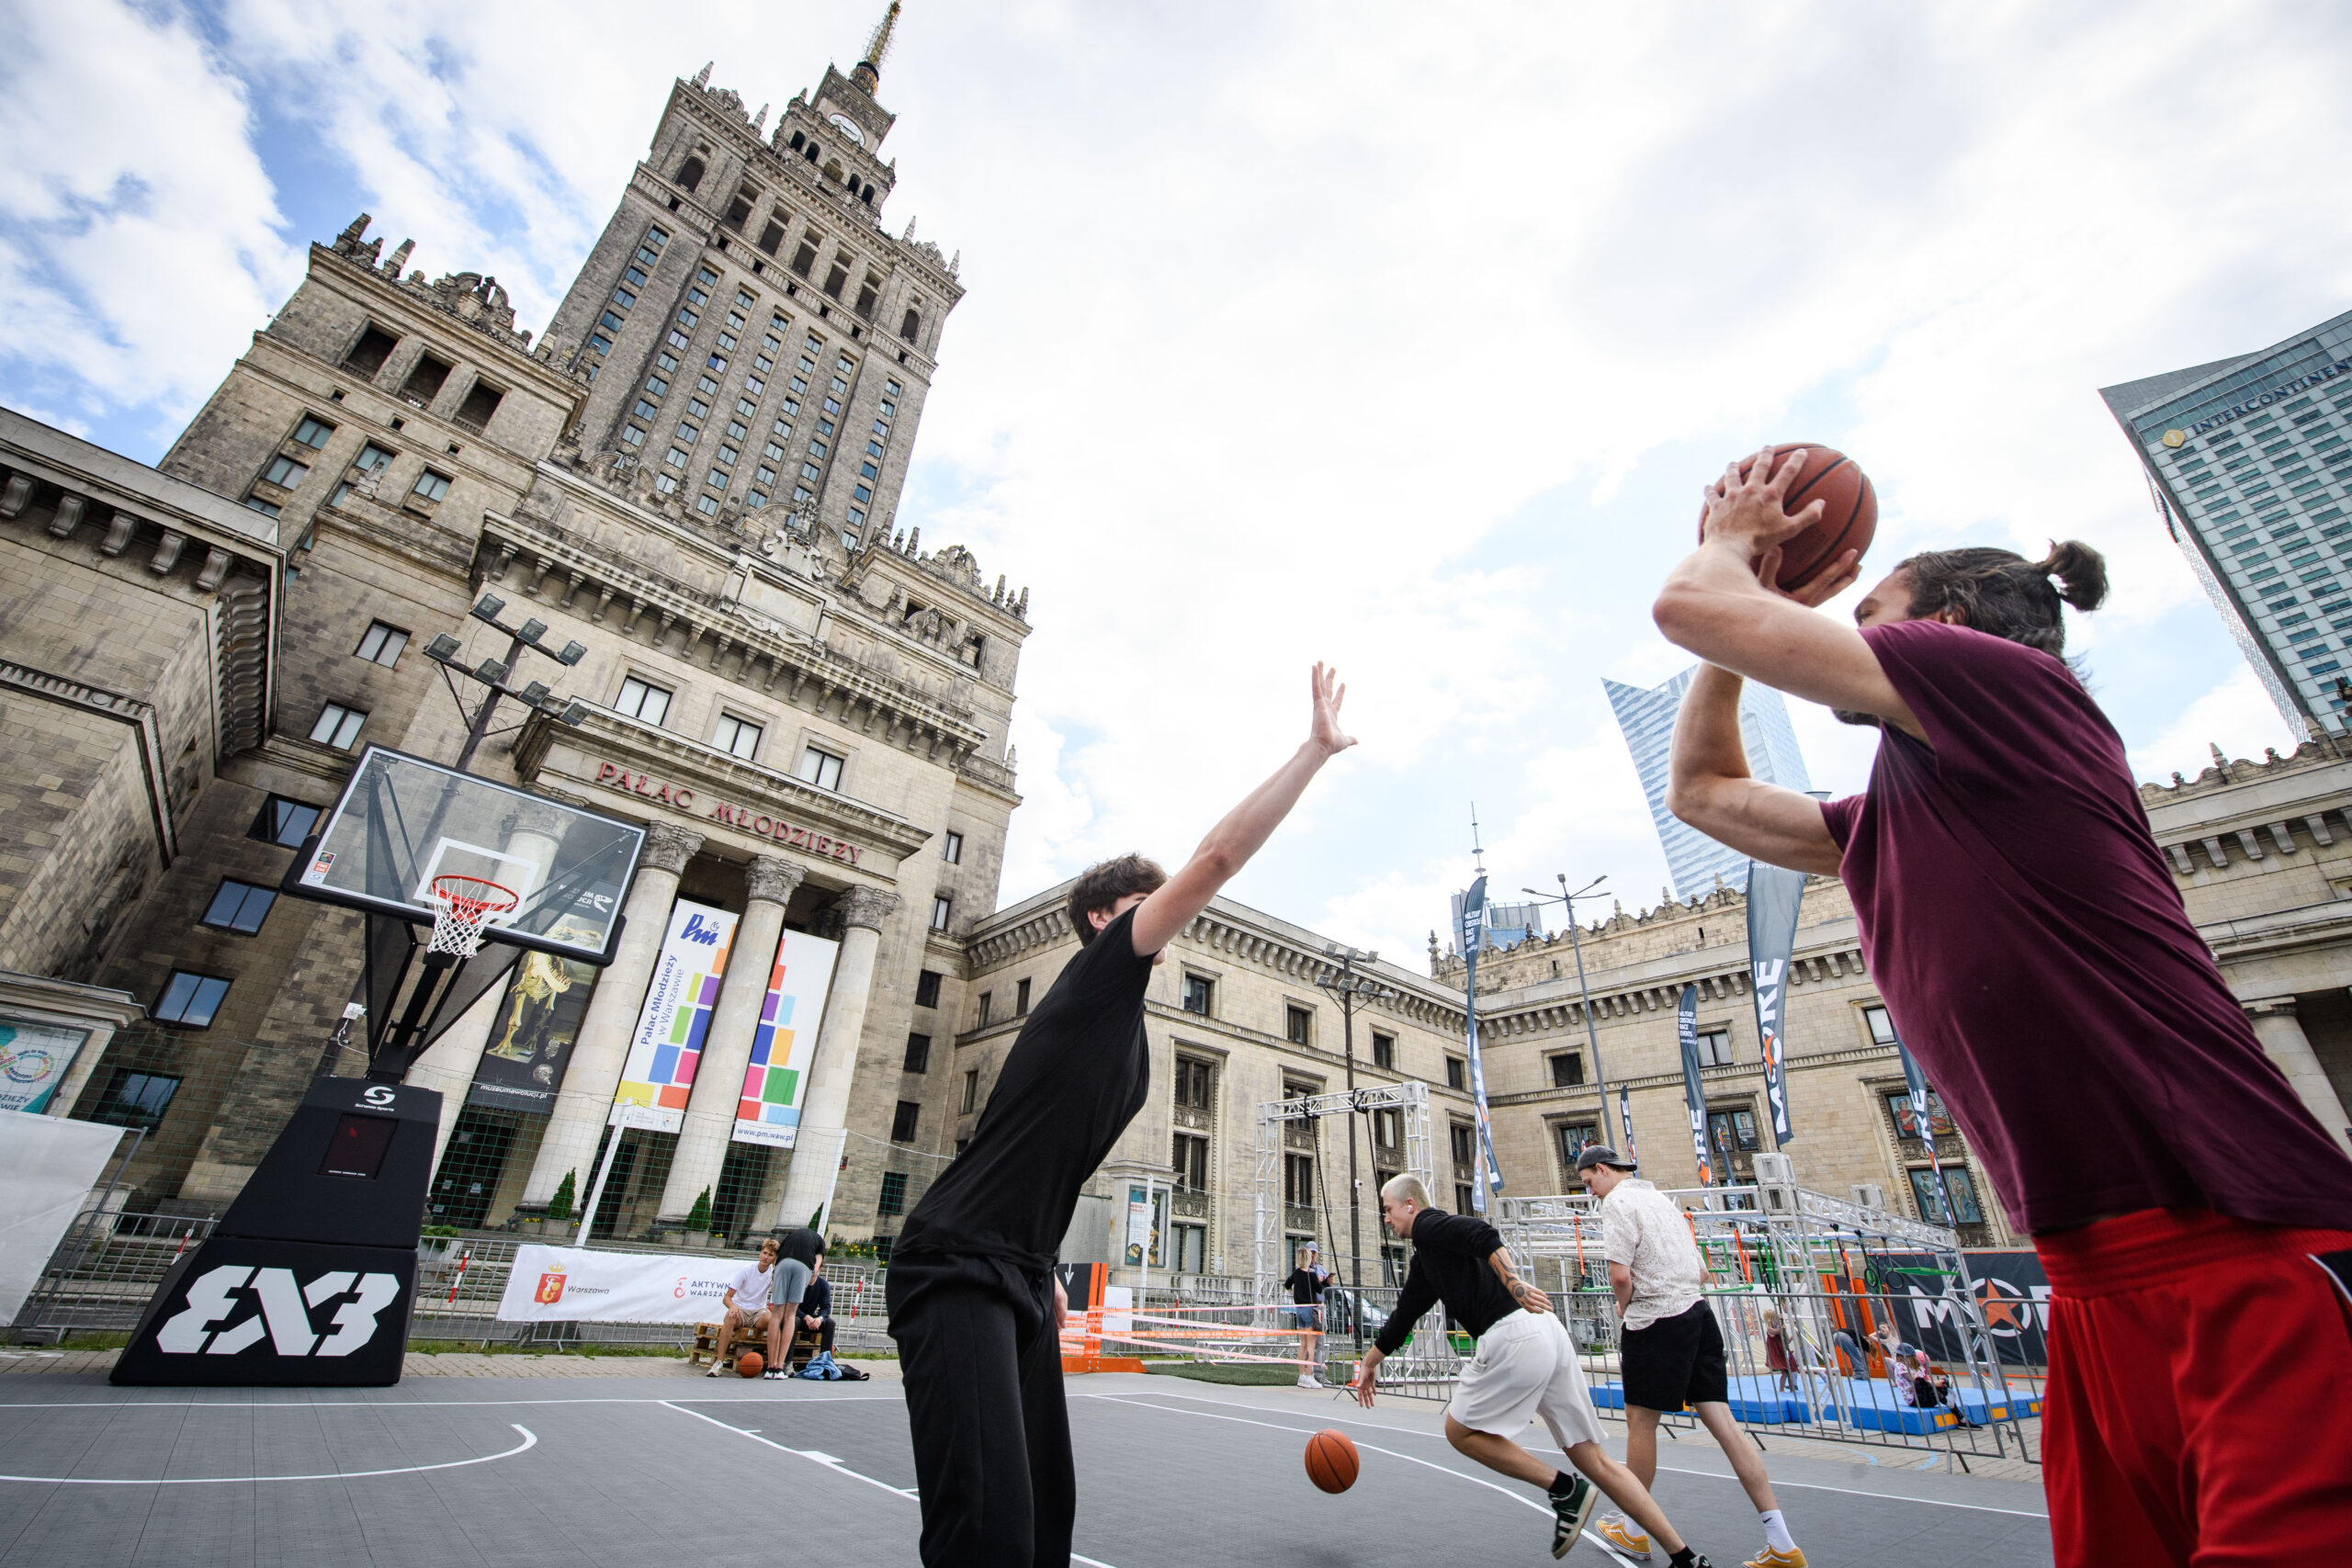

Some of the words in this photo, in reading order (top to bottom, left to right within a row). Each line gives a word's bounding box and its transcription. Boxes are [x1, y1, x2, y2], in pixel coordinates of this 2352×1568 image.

[2190, 356, 2352, 435] INTERCONTINEN
[596, 761, 695, 808] PAŁAC
[640, 1015, 658, 1045] Pałac
[650, 955, 677, 1012] Młodzieży
[660, 968, 684, 1025] Warszawie
[738, 1128, 794, 1142] www.pm.waw.pl
[1622, 1100, 1637, 1165] ORE
[567, 1285, 610, 1294] Warszawa
